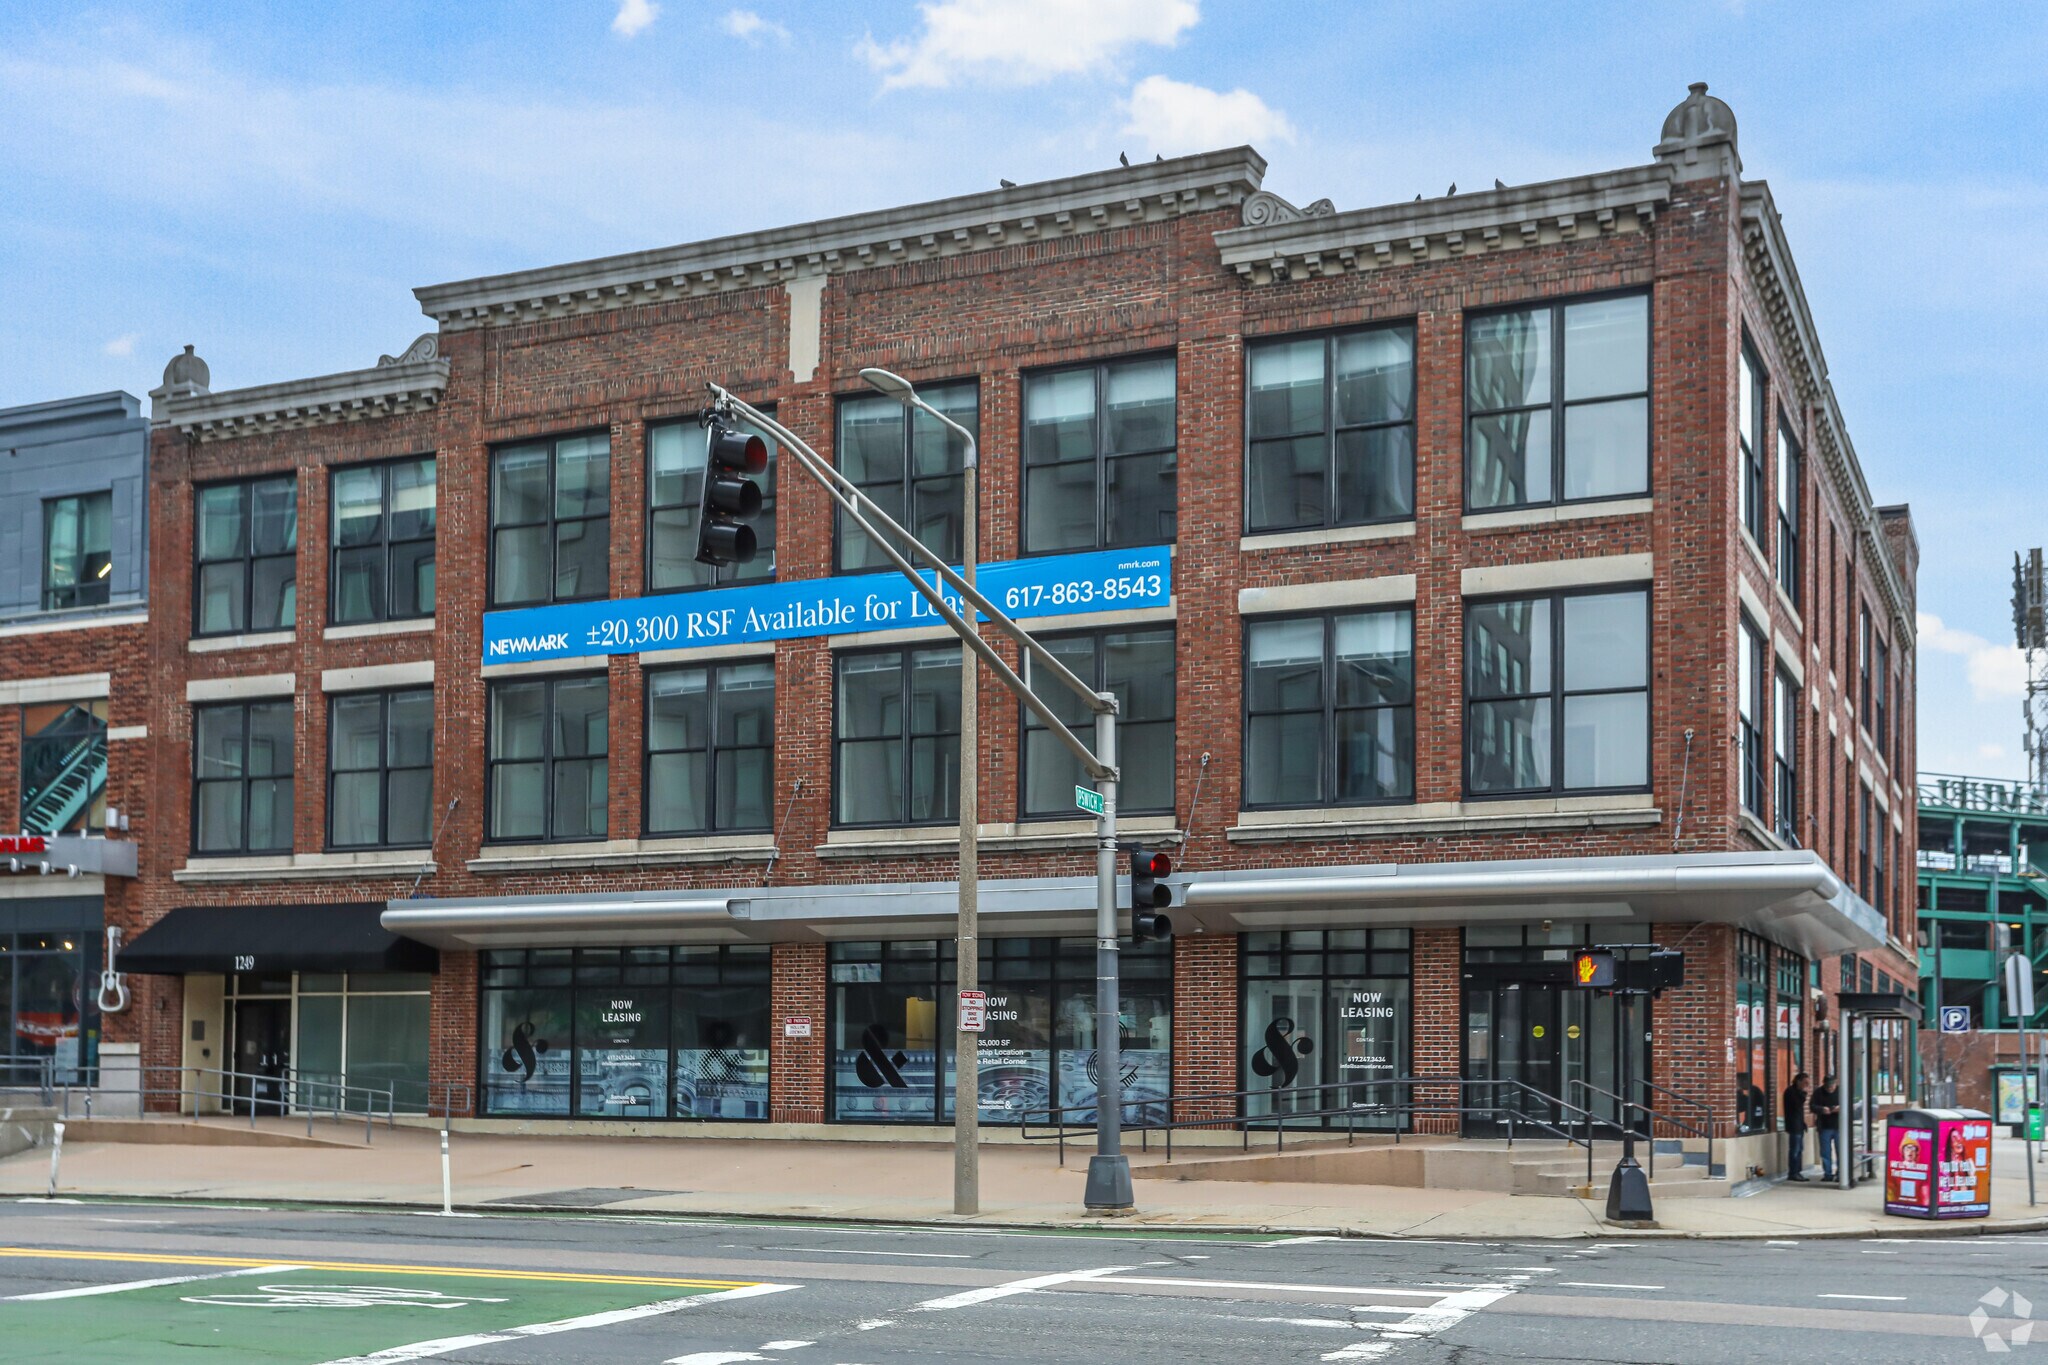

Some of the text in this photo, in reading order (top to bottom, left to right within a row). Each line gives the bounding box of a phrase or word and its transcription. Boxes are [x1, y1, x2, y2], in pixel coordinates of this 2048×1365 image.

[1118, 560, 1160, 570] nmrk.com
[1005, 574, 1162, 610] 617-863-8543
[586, 590, 981, 648] ±20,300 RSF Available for Las
[489, 632, 569, 656] NEWMARK
[234, 954, 255, 970] 1249
[985, 997, 1007, 1007] NOW
[1353, 993, 1382, 1003] NOW
[611, 1000, 633, 1010] NOW
[602, 1013, 641, 1022] LEASING
[985, 1011, 1018, 1021] ASING
[1341, 1007, 1394, 1018] LEASING
[1948, 1012, 1962, 1028] P
[978, 1039, 1000, 1047] 35,000
